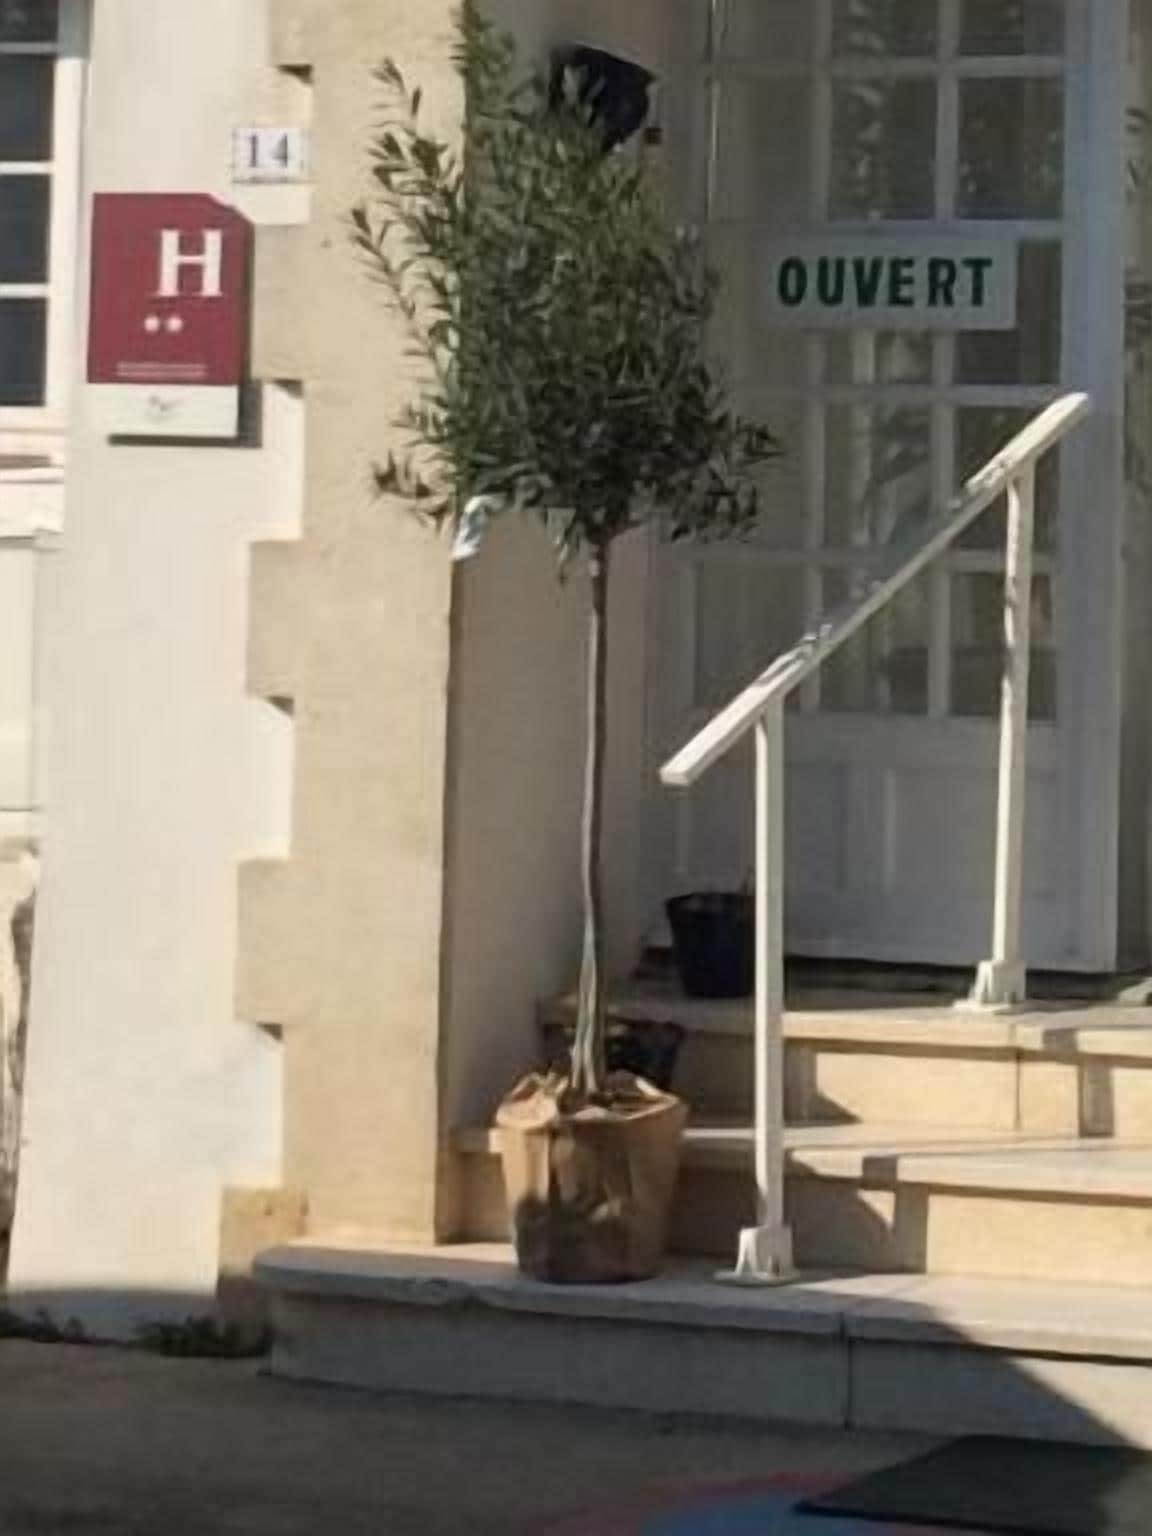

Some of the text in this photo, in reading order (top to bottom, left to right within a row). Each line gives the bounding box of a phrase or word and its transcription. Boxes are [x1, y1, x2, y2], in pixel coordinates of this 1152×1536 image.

[247, 132, 289, 169] 14
[154, 227, 223, 298] H
[777, 255, 994, 308] OUVERT
